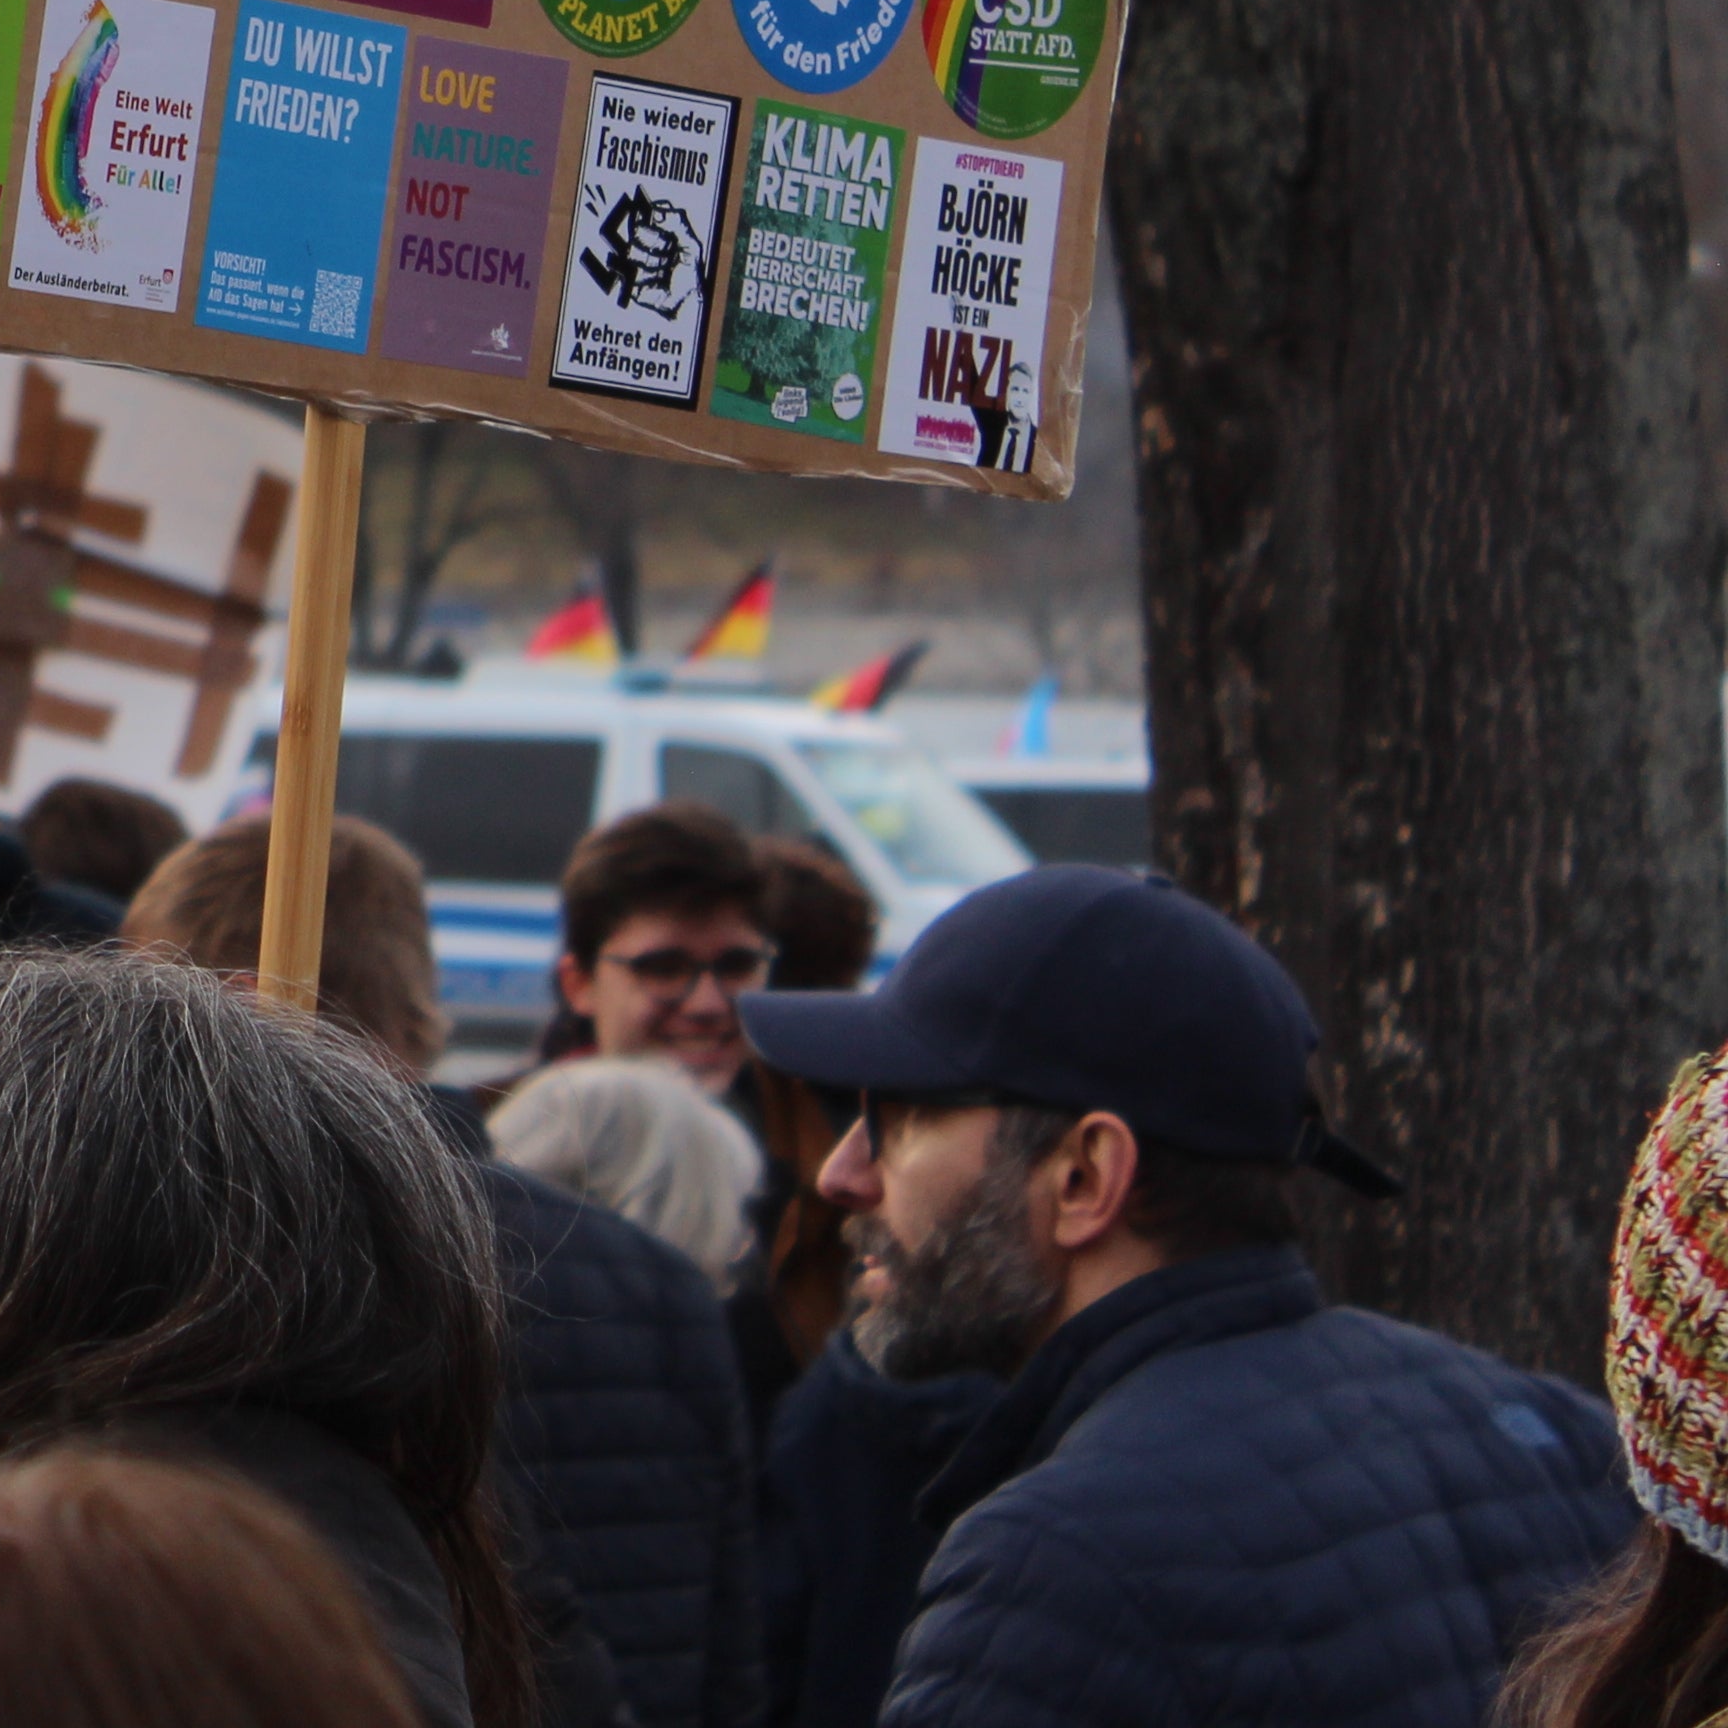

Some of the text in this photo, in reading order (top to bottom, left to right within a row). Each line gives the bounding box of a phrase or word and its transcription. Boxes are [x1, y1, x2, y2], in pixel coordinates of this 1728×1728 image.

[244, 17, 392, 87] DU WILLST
[750, 0, 784, 50] für
[783, 41, 831, 75] den
[969, 27, 1076, 59] STATT AFD.
[115, 90, 192, 120] Eine Welt
[235, 77, 359, 143] FRIEDEN?
[420, 65, 495, 113] LOVE
[602, 96, 716, 137] Nie wieder
[110, 120, 188, 162] Erfurt
[412, 122, 540, 175] NATURE.
[596, 127, 709, 186] Faschismus
[761, 113, 893, 189] KLIMA
[106, 163, 182, 194] Für Alle!
[406, 178, 470, 222] NOT
[755, 165, 890, 231] RETTEN
[937, 179, 1028, 244] BJÖRN
[399, 234, 531, 290] FASCISM.
[748, 228, 856, 272] BEDEUTET
[931, 239, 1022, 307] HÖCKE
[14, 268, 34, 283] Der
[36, 269, 129, 298] Ausländerbeirat.
[745, 255, 865, 298] HERRSCHAFT
[740, 281, 869, 332] BRECHEN!
[952, 305, 989, 329] IST EIN
[573, 319, 682, 355] Wehret den
[569, 342, 681, 382] Anfängen!
[918, 327, 1013, 410] NAZI
